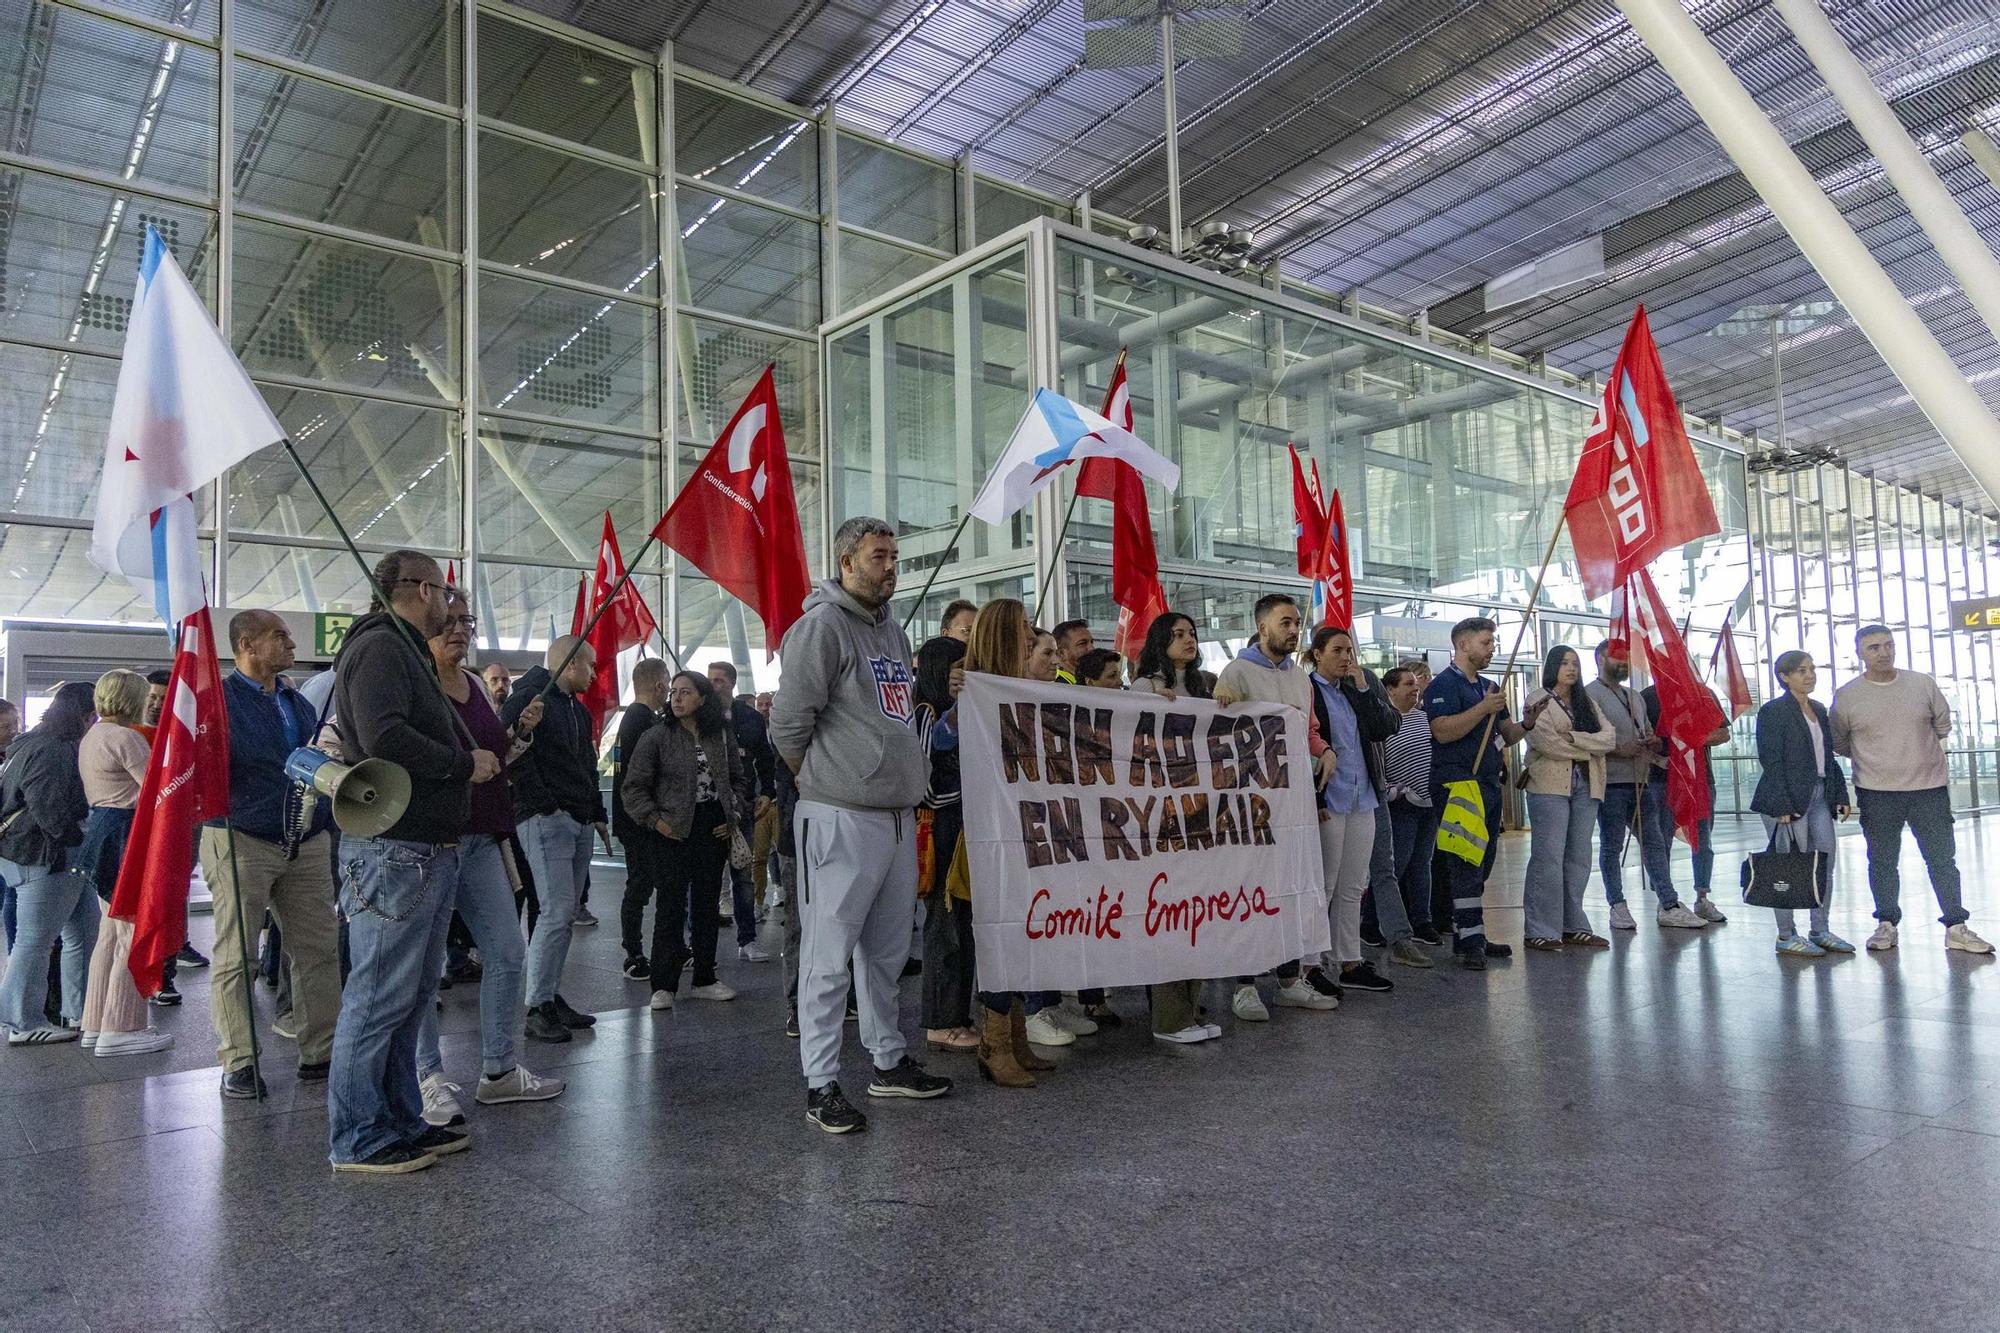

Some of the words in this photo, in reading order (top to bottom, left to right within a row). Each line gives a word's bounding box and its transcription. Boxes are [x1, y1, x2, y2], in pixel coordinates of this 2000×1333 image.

[998, 702, 1116, 786] NON
[1129, 710, 1200, 788] AO
[1207, 714, 1290, 790] ERE
[1019, 796, 1090, 868] EN
[1099, 792, 1276, 861] RYANAIR
[1026, 884, 1124, 940] Comité
[1144, 872, 1280, 947] Empresa
